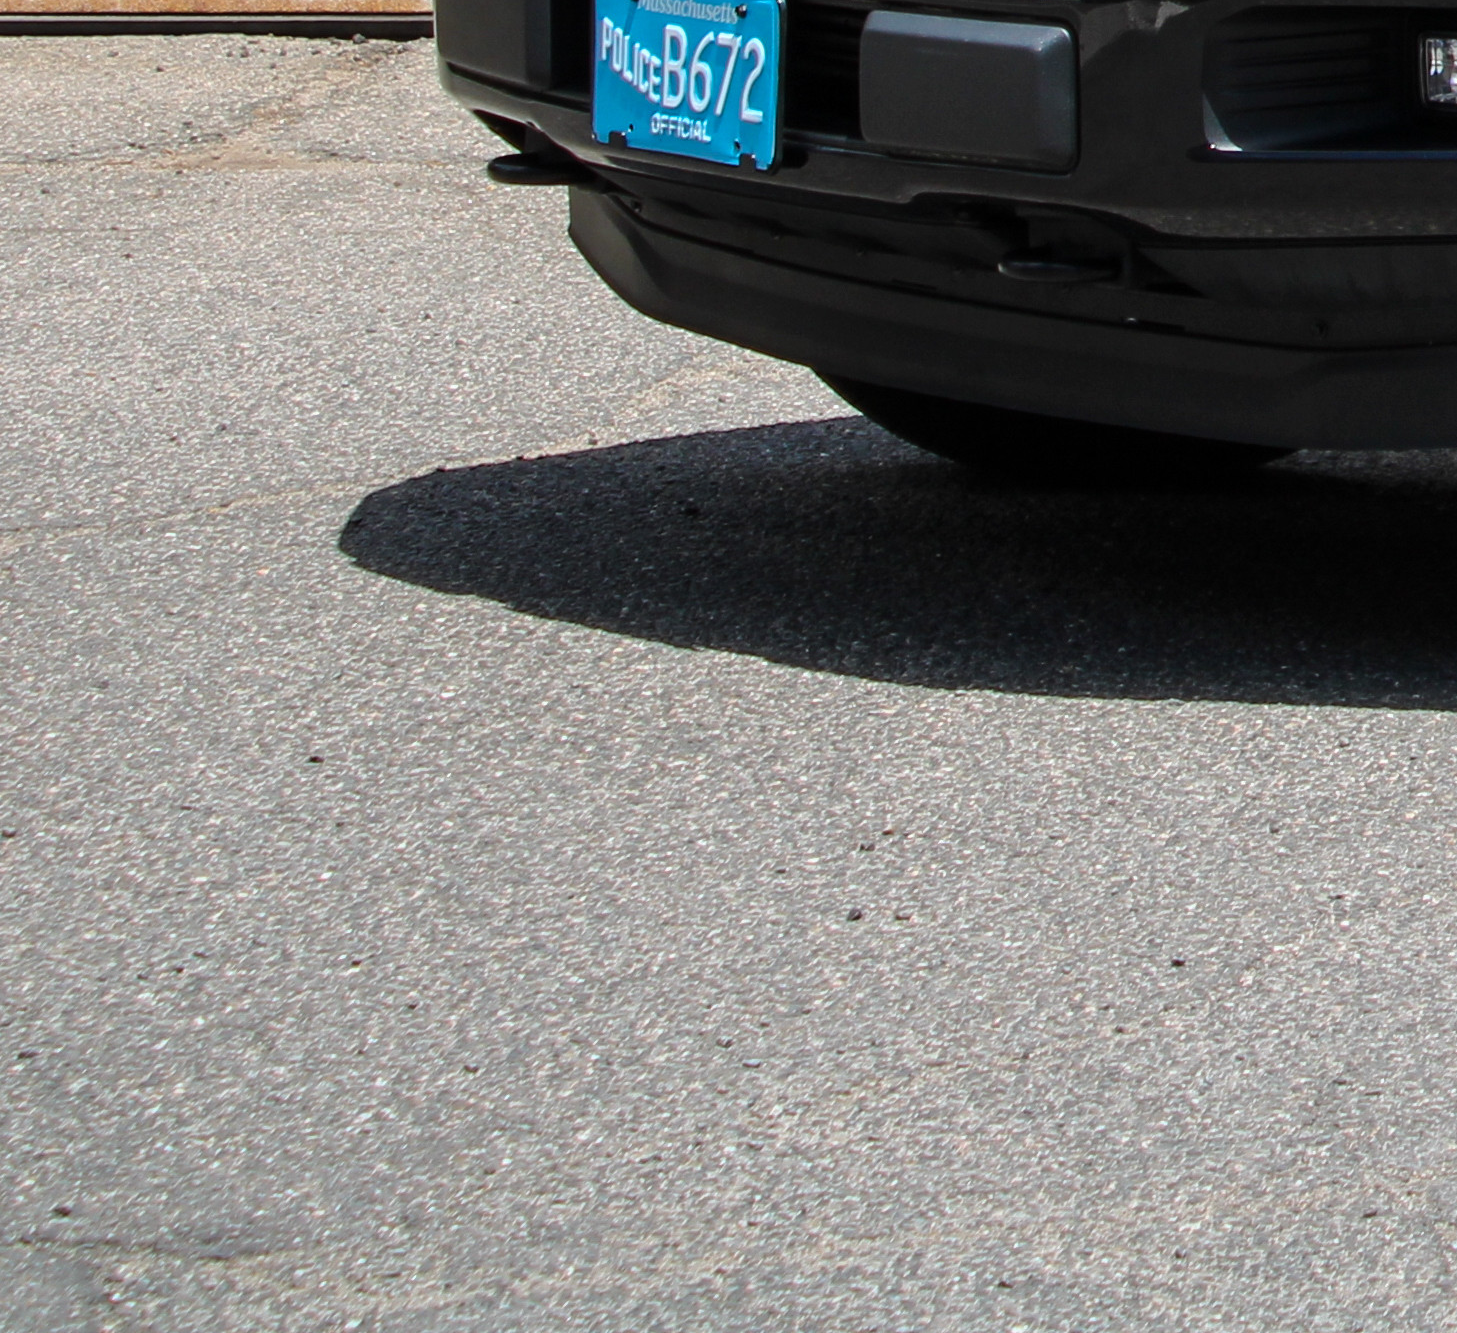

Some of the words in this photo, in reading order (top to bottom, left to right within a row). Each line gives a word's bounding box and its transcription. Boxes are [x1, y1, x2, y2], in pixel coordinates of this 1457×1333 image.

[601, 16, 663, 104] POLICE
[662, 24, 765, 123] B672
[651, 112, 712, 143] OFFICIAL
